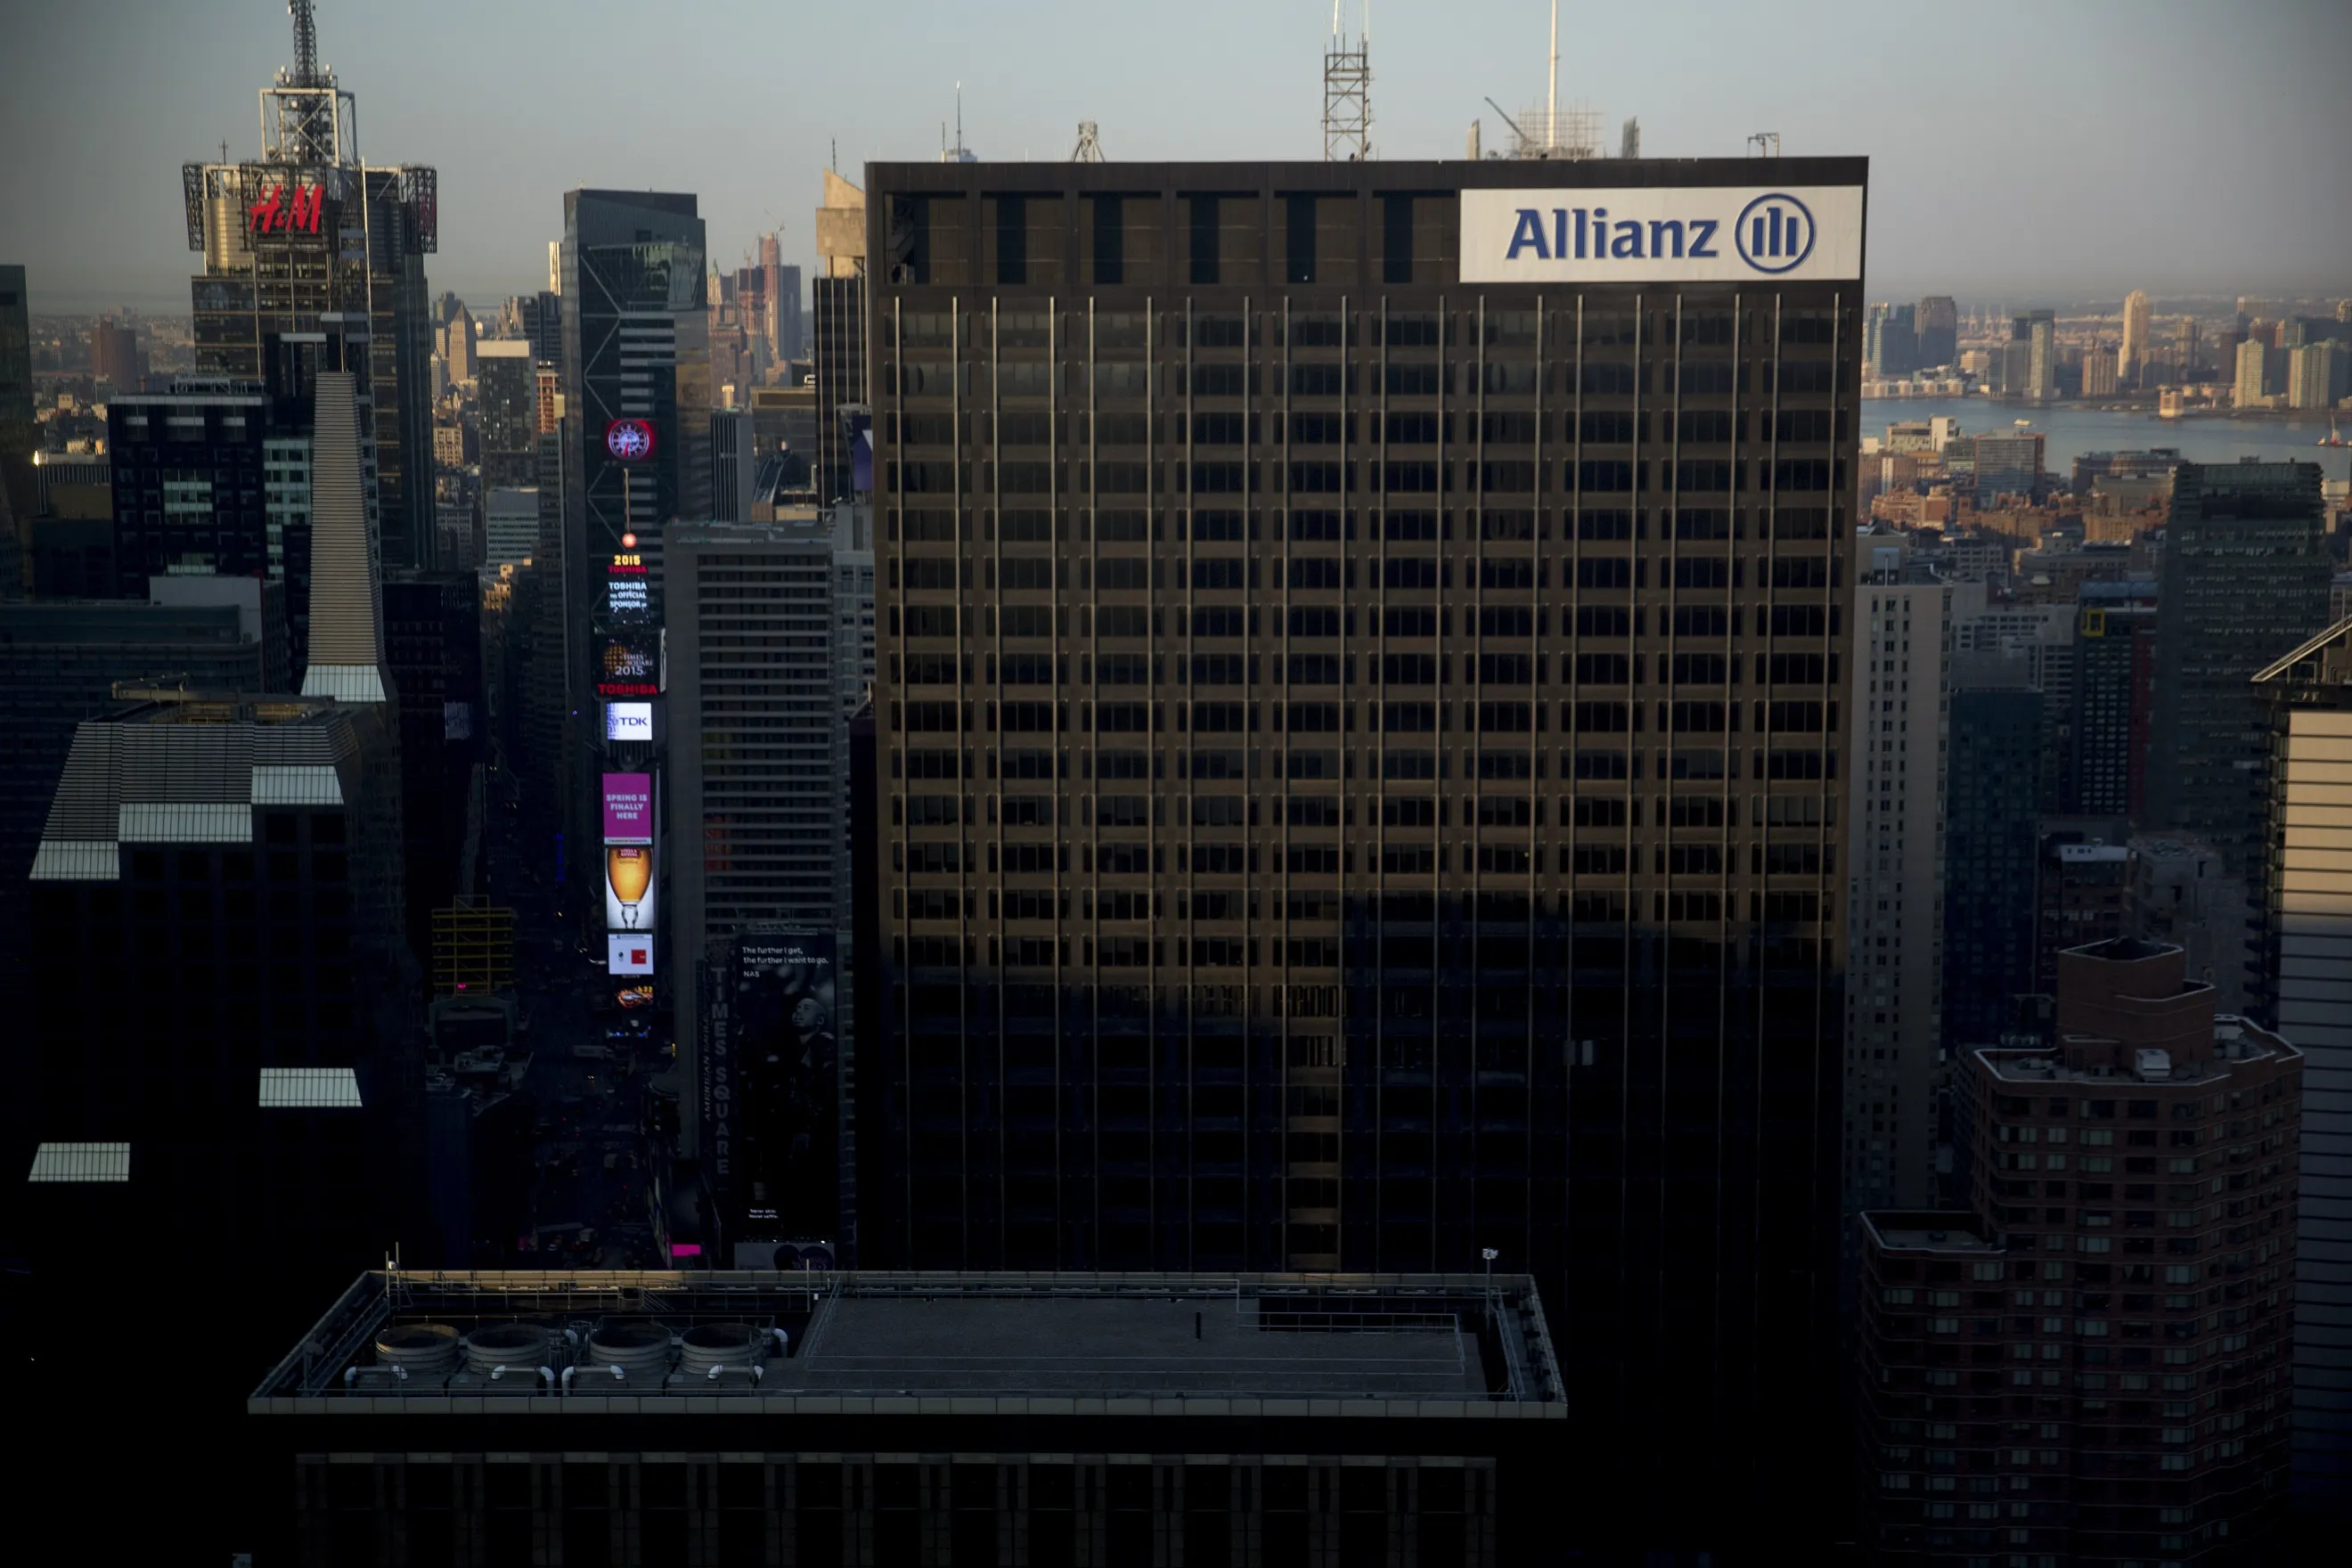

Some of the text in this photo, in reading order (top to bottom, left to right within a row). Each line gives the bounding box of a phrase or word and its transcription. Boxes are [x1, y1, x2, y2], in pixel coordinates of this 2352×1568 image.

[249, 184, 323, 235] H&M
[1506, 208, 1719, 260] Allianz
[613, 554, 641, 566] 2015
[608, 582, 647, 591] TOSHIBA
[615, 666, 644, 676] 2015
[598, 683, 658, 695] TOSHIBA
[619, 717, 648, 725] TDK
[742, 946, 756, 954] The
[757, 946, 783, 954] further
[788, 947, 803, 955] get,
[743, 956, 756, 964] the
[757, 956, 783, 964] further
[743, 970, 760, 978] NAS
[711, 967, 731, 1174] TIMES SQUARE
